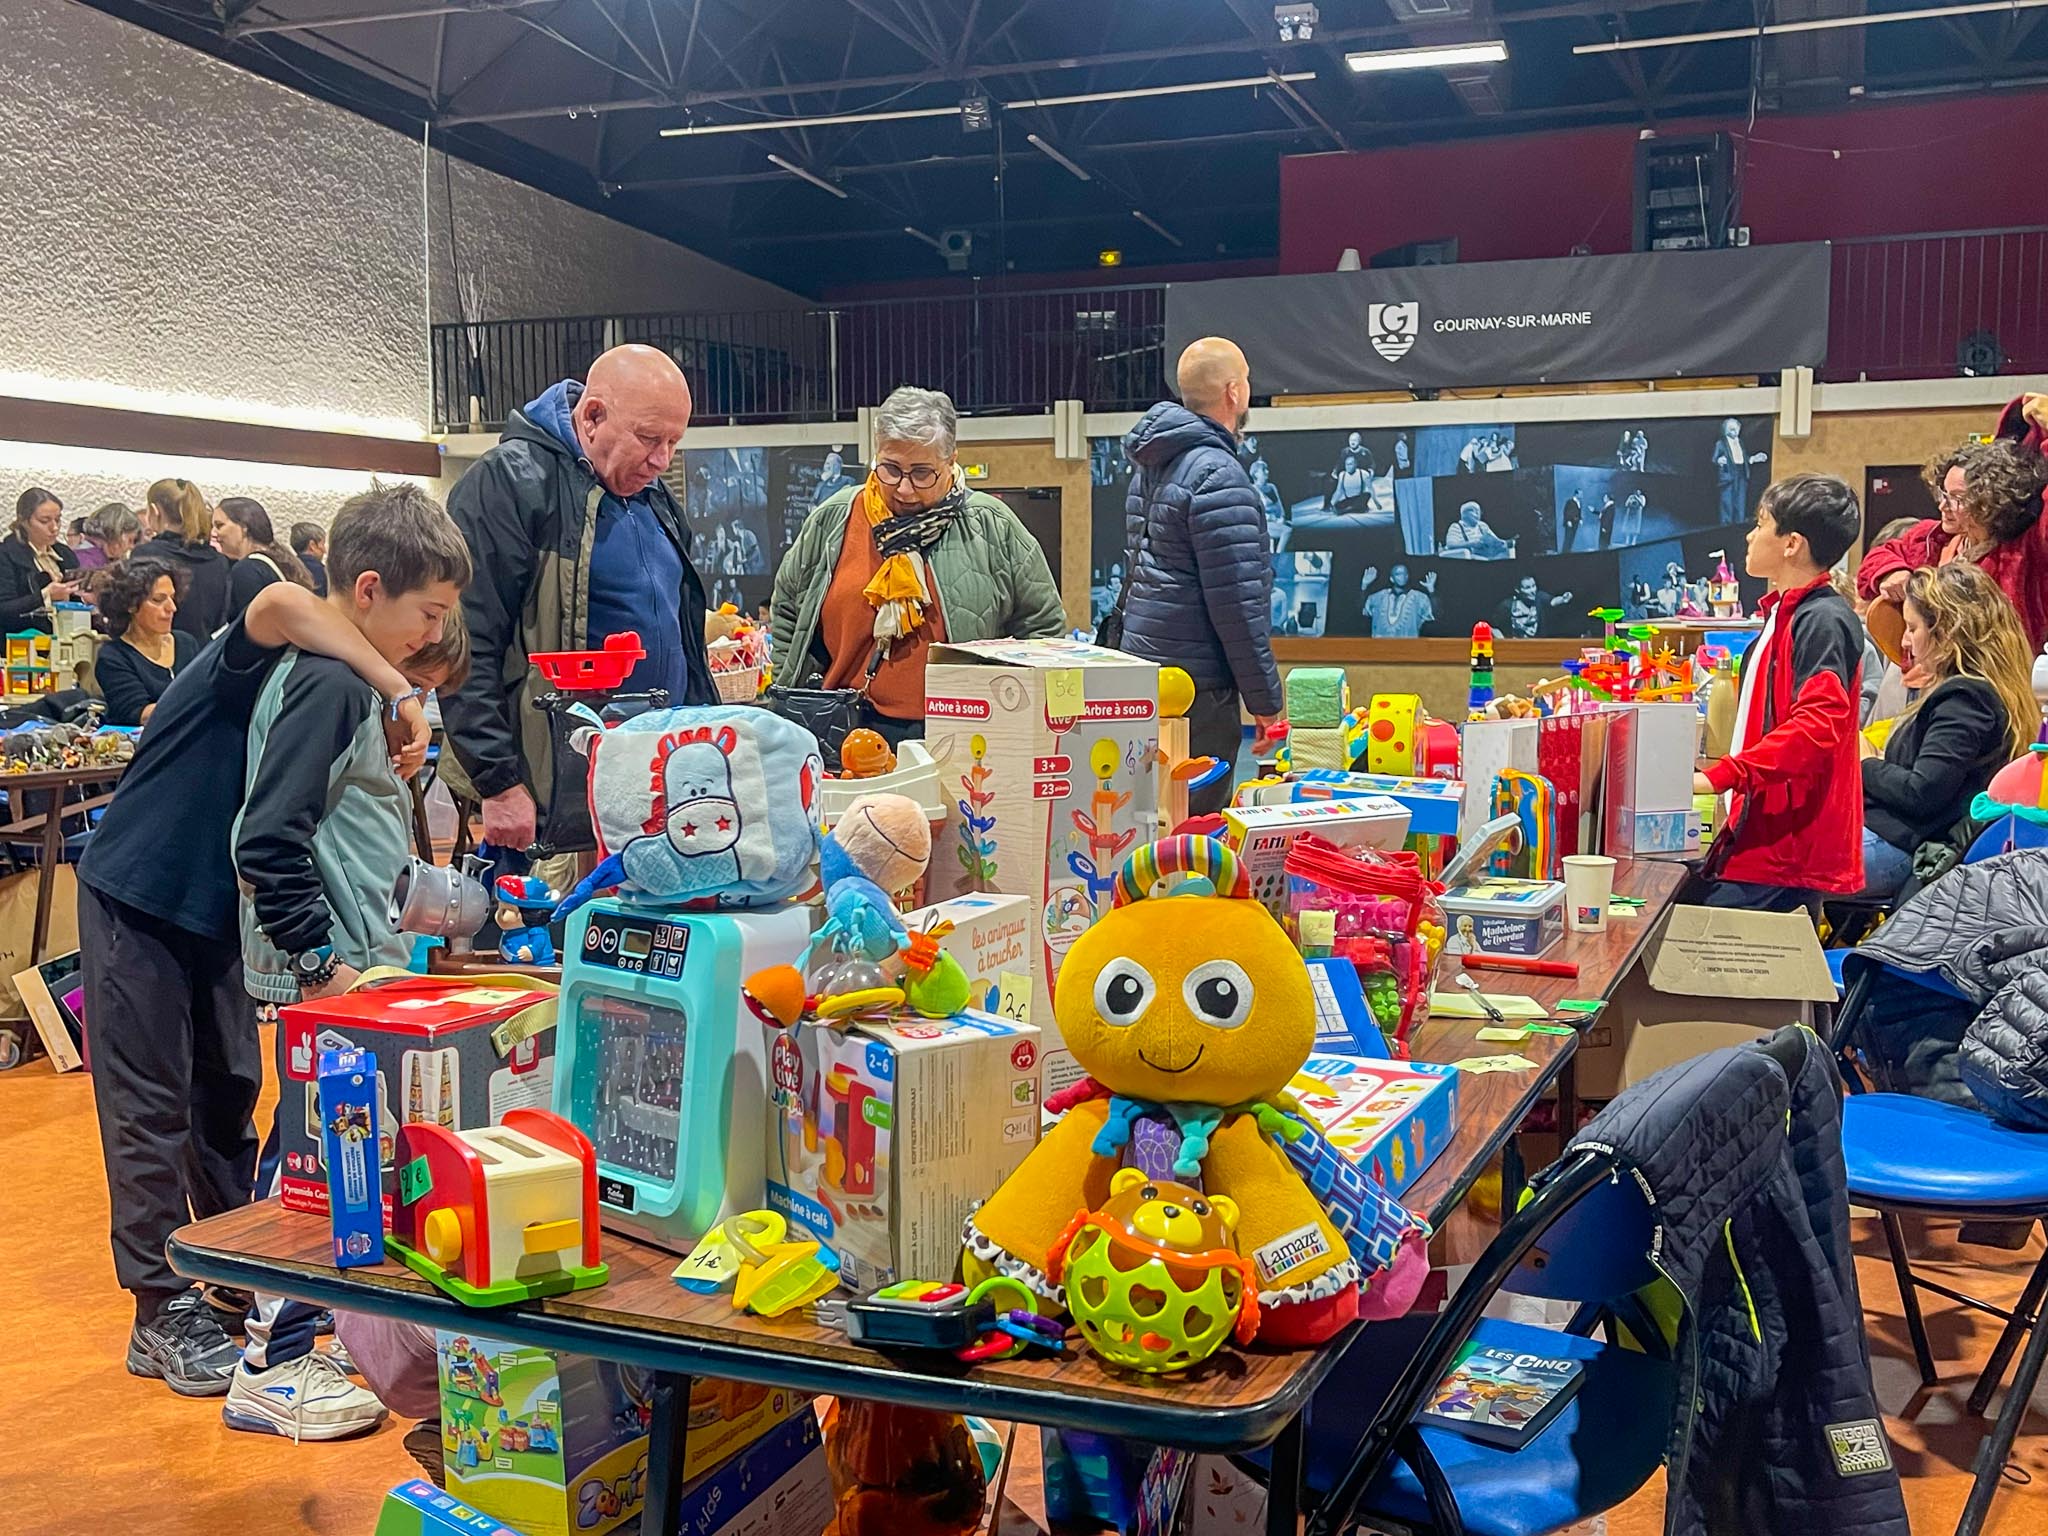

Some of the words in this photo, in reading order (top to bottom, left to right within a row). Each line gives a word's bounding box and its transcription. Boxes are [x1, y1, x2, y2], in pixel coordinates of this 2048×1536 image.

[1433, 311, 1592, 333] GOURNAY-SUR-MARNE
[928, 702, 954, 713] Arbre
[955, 701, 961, 713] à
[962, 705, 985, 715] sons
[1085, 704, 1113, 716] Arbre
[1114, 702, 1121, 716] à
[1123, 706, 1148, 716] sons
[1041, 759, 1056, 771] 3+
[1041, 784, 1055, 796] 23
[972, 926, 986, 950] les
[987, 917, 1026, 945] animaux
[1482, 923, 1526, 939] Madeleines
[977, 950, 986, 973] à
[986, 938, 1024, 970] toucher
[869, 1053, 889, 1074] 2-6
[865, 1103, 875, 1117] 10
[771, 1189, 805, 1216] Machine
[805, 1204, 812, 1220] à
[811, 1211, 829, 1230] café
[693, 1250, 721, 1269] 1€
[1257, 1231, 1319, 1269] Lamaze
[1485, 1349, 1514, 1361] LES
[1512, 1354, 1572, 1373] CINQ
